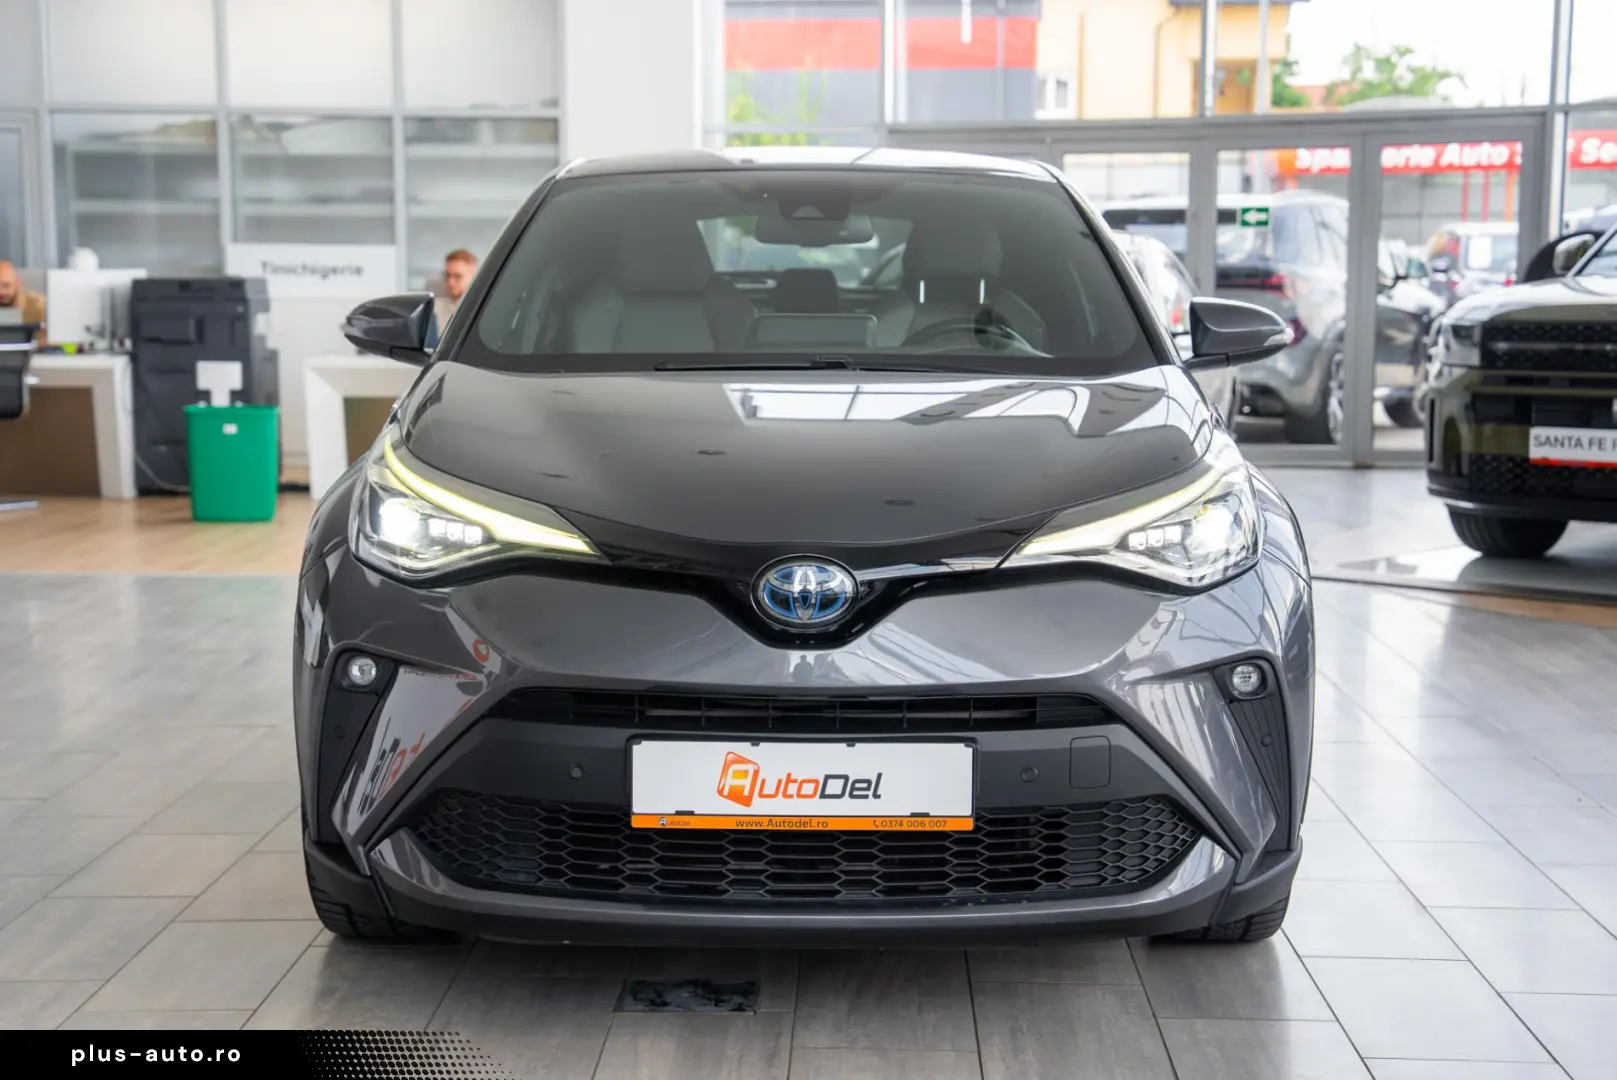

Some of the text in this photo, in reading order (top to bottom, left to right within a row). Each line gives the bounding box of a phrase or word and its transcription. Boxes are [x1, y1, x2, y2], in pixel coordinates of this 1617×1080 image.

[1439, 142, 1510, 167] Auto
[1533, 434, 1584, 451] SANTA
[1588, 437, 1606, 452] FE
[720, 762, 883, 800] AutoDel
[735, 818, 829, 829] www.Autodel.ro
[880, 819, 947, 828] 0374 006 007
